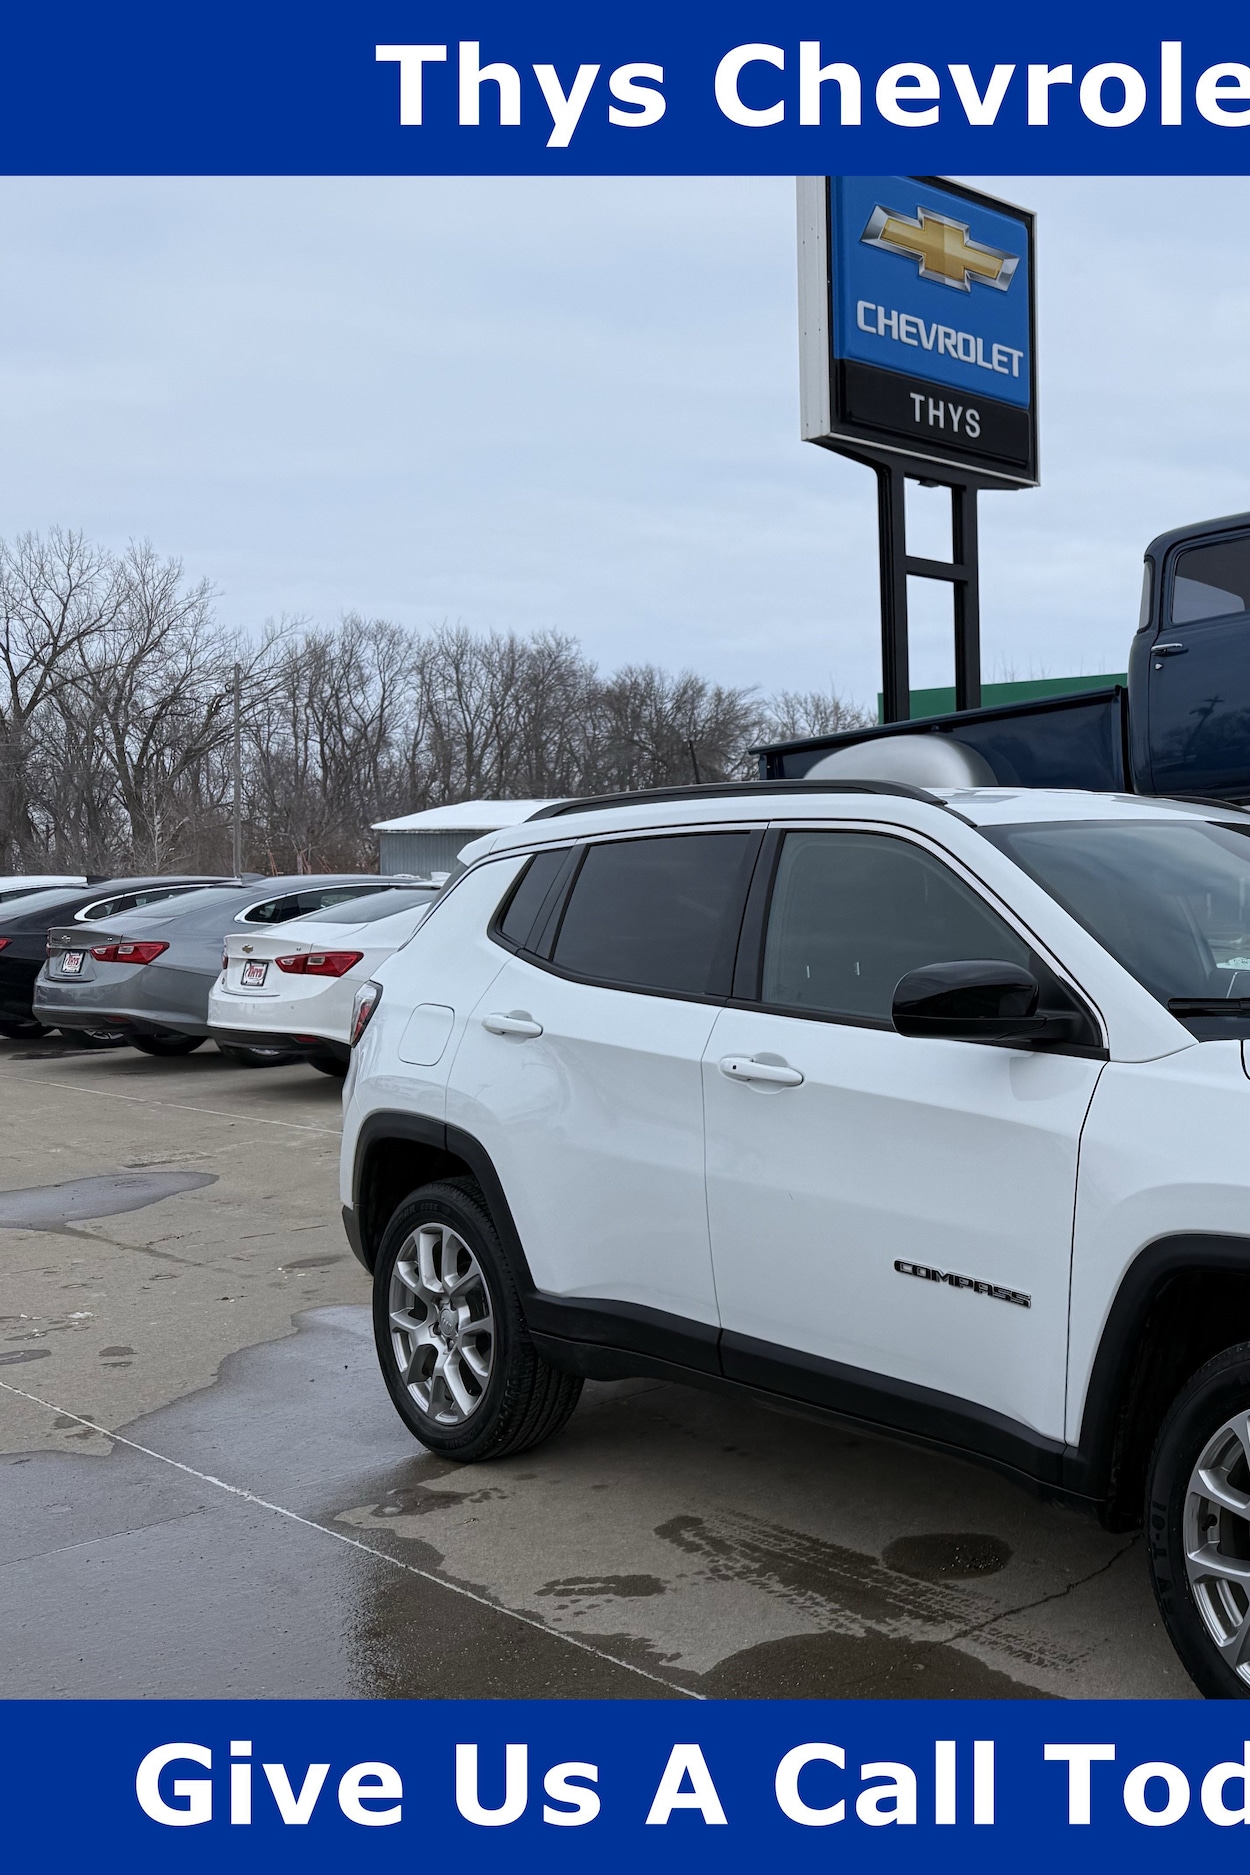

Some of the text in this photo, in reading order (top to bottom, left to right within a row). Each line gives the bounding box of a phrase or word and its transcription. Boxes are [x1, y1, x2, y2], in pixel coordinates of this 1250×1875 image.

[857, 300, 1023, 378] CHEVROLET
[909, 392, 981, 438] THYS
[893, 1258, 1032, 1309] COMPASS
